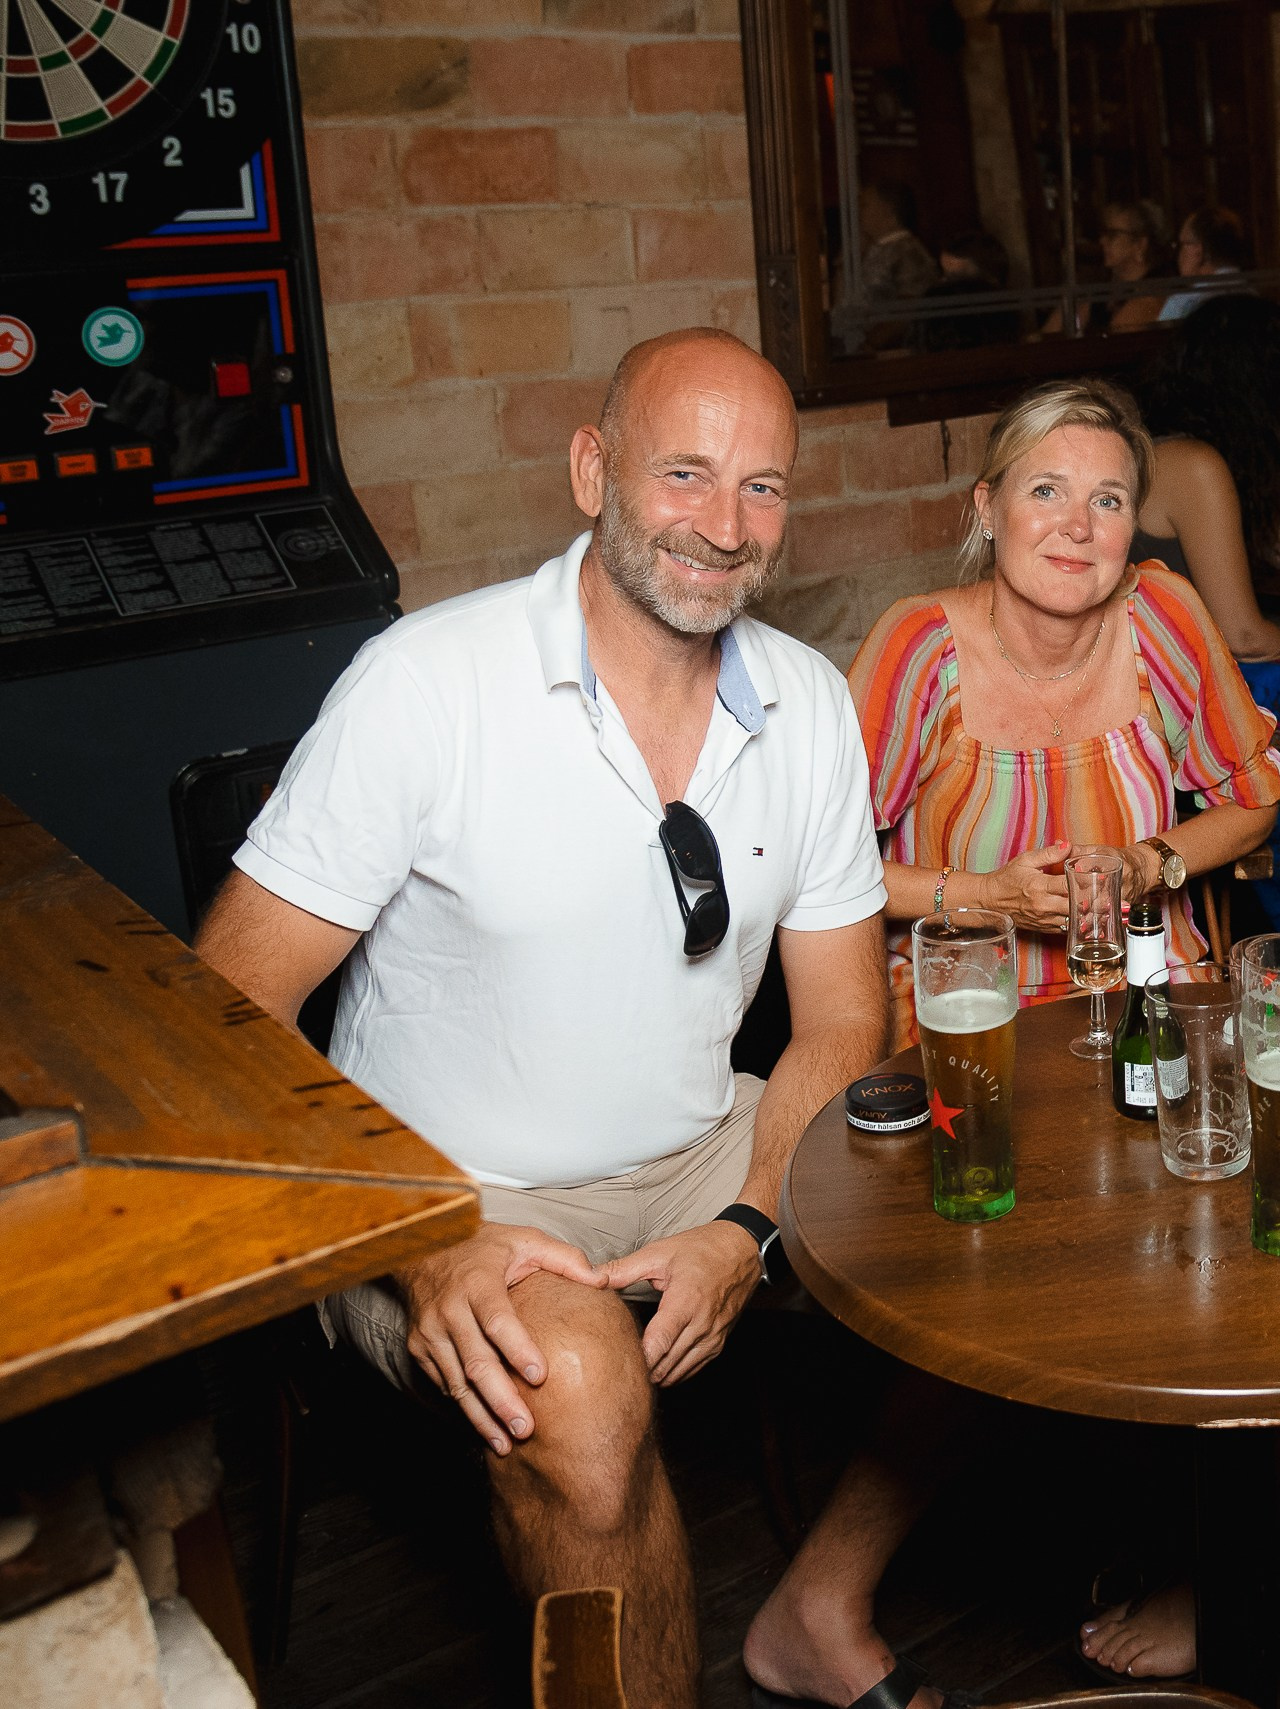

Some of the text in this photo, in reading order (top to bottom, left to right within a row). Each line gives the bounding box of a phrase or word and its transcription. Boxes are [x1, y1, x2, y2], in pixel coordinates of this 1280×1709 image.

[226, 22, 261, 54] 10
[200, 87, 237, 119] 15
[162, 136, 183, 167] 2
[28, 183, 51, 215] 3
[92, 172, 129, 203] 17
[861, 1083, 915, 1097] KNOX
[948, 1055, 999, 1102] QUALITY
[855, 1119, 877, 1130] skadar
[877, 1121, 902, 1130] hälsan
[903, 1119, 917, 1128] och
